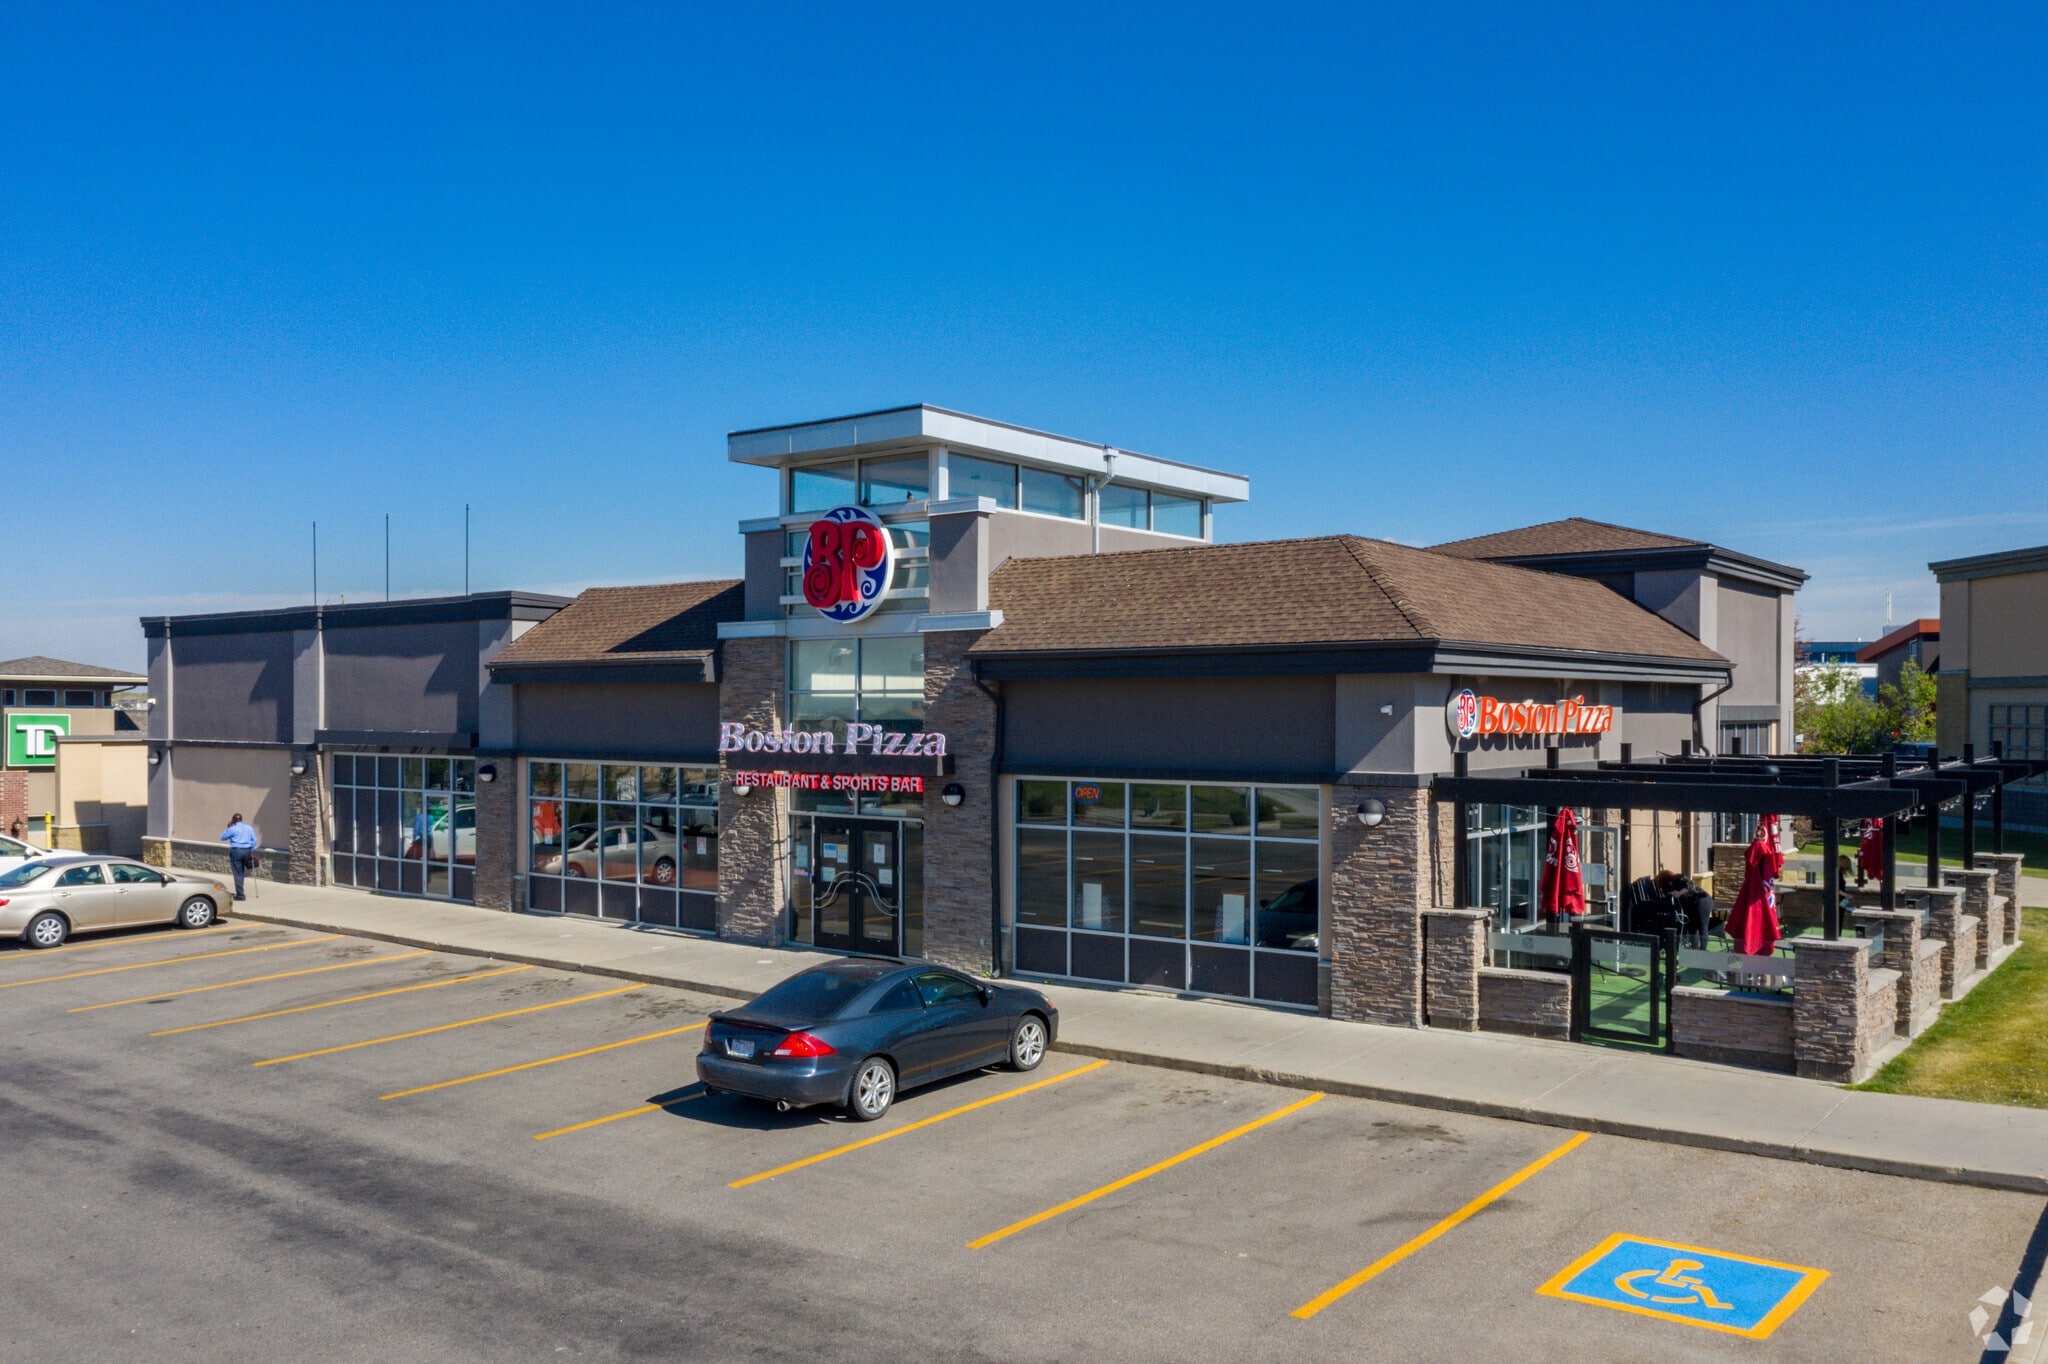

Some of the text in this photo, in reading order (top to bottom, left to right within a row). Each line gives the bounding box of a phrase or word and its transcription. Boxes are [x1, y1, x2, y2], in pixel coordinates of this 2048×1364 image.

[803, 520, 885, 608] BP
[1479, 695, 1614, 735] Boston Pizza
[16, 724, 65, 755] TD
[718, 722, 947, 757] Boston Pizza
[735, 772, 922, 793] RESTAURANT & SPORTS BAR
[1075, 787, 1099, 799] OPEN
